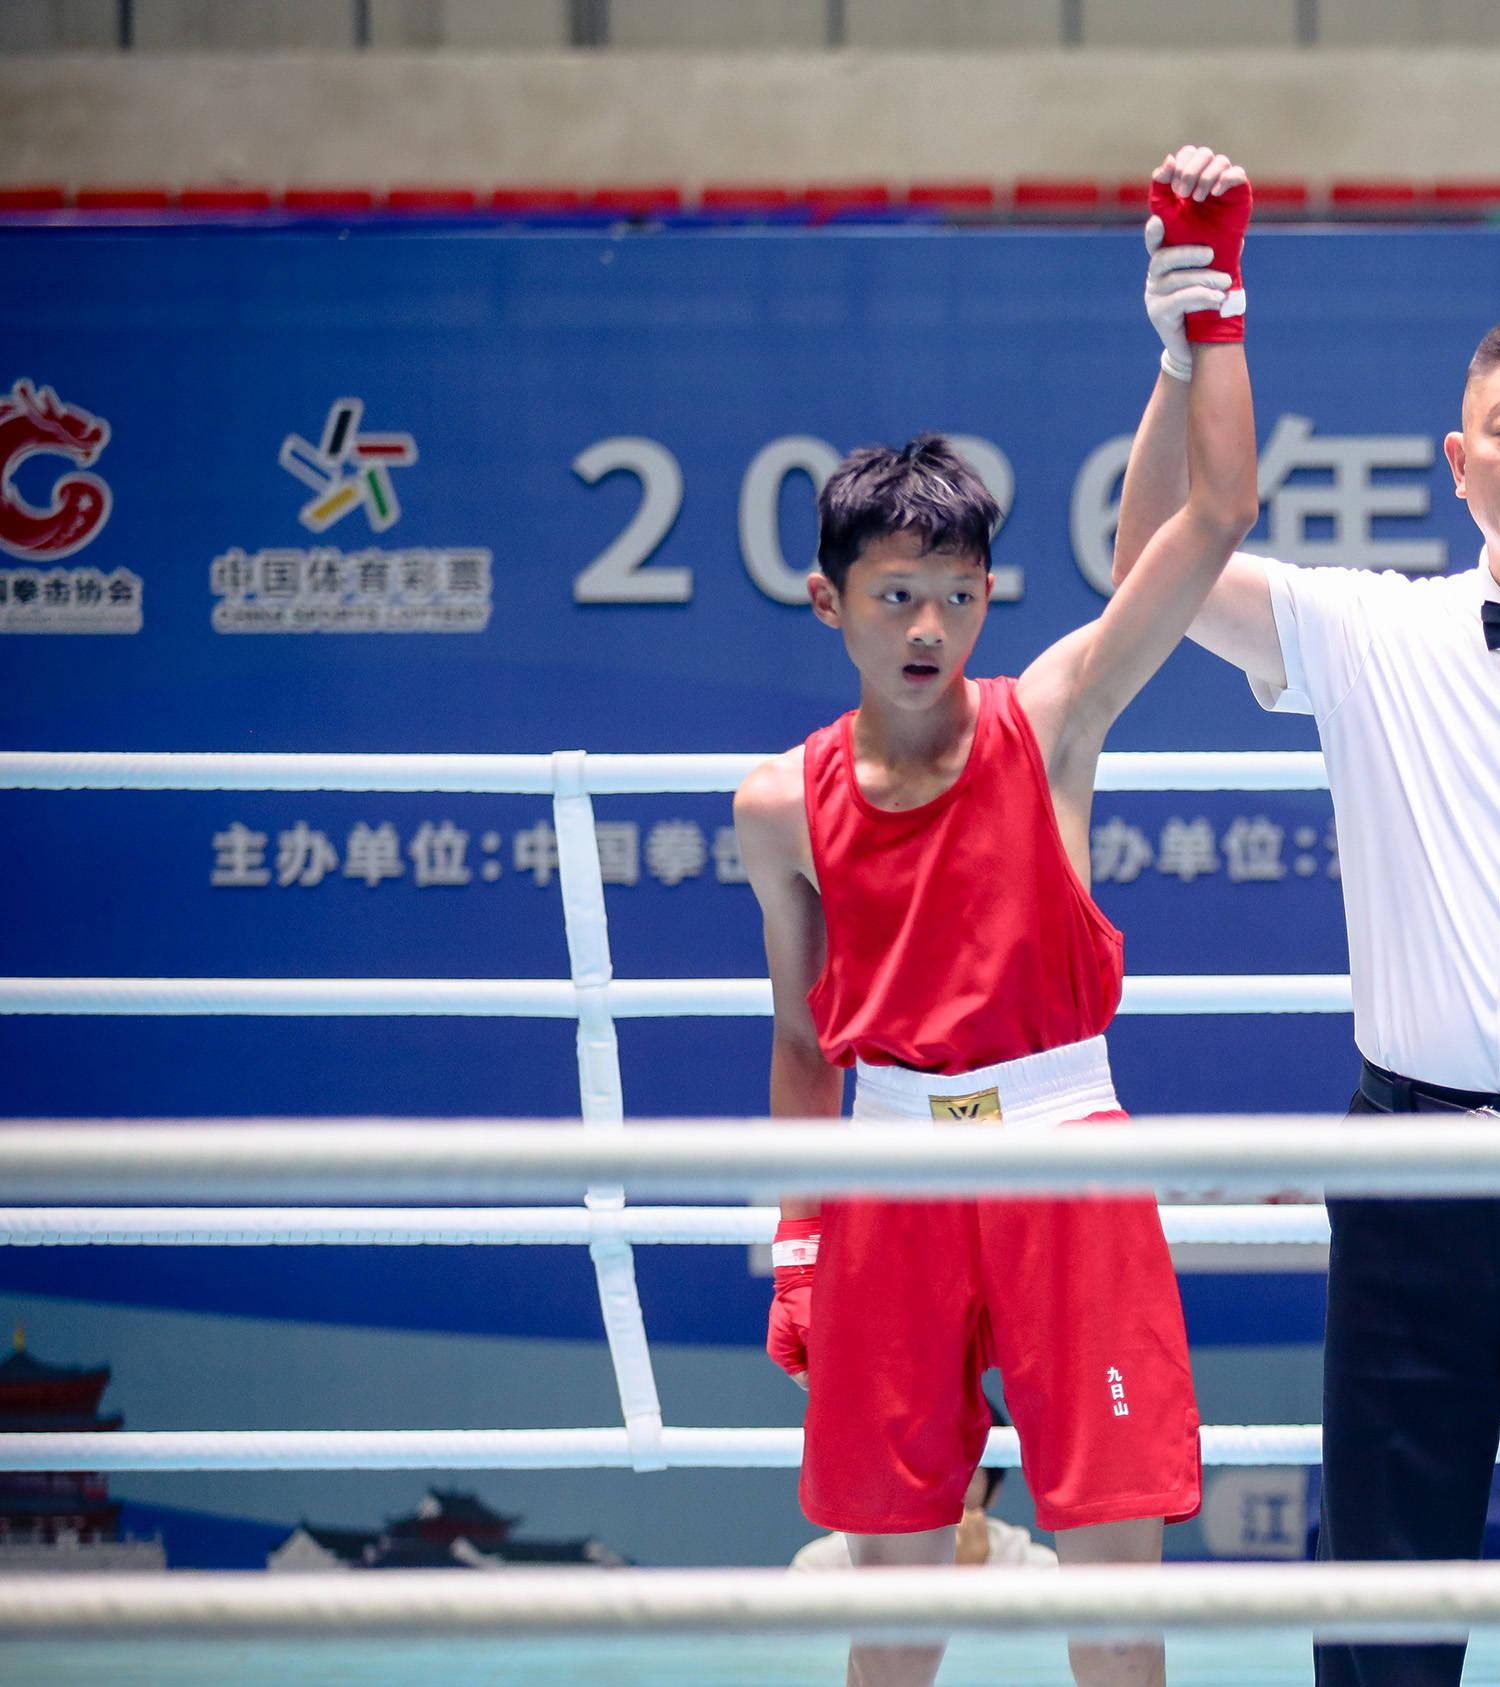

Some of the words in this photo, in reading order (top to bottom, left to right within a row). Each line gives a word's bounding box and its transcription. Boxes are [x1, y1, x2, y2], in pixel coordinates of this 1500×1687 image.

[0, 577, 133, 604] 拳击协会
[1107, 1366, 1129, 1416] 九日山
